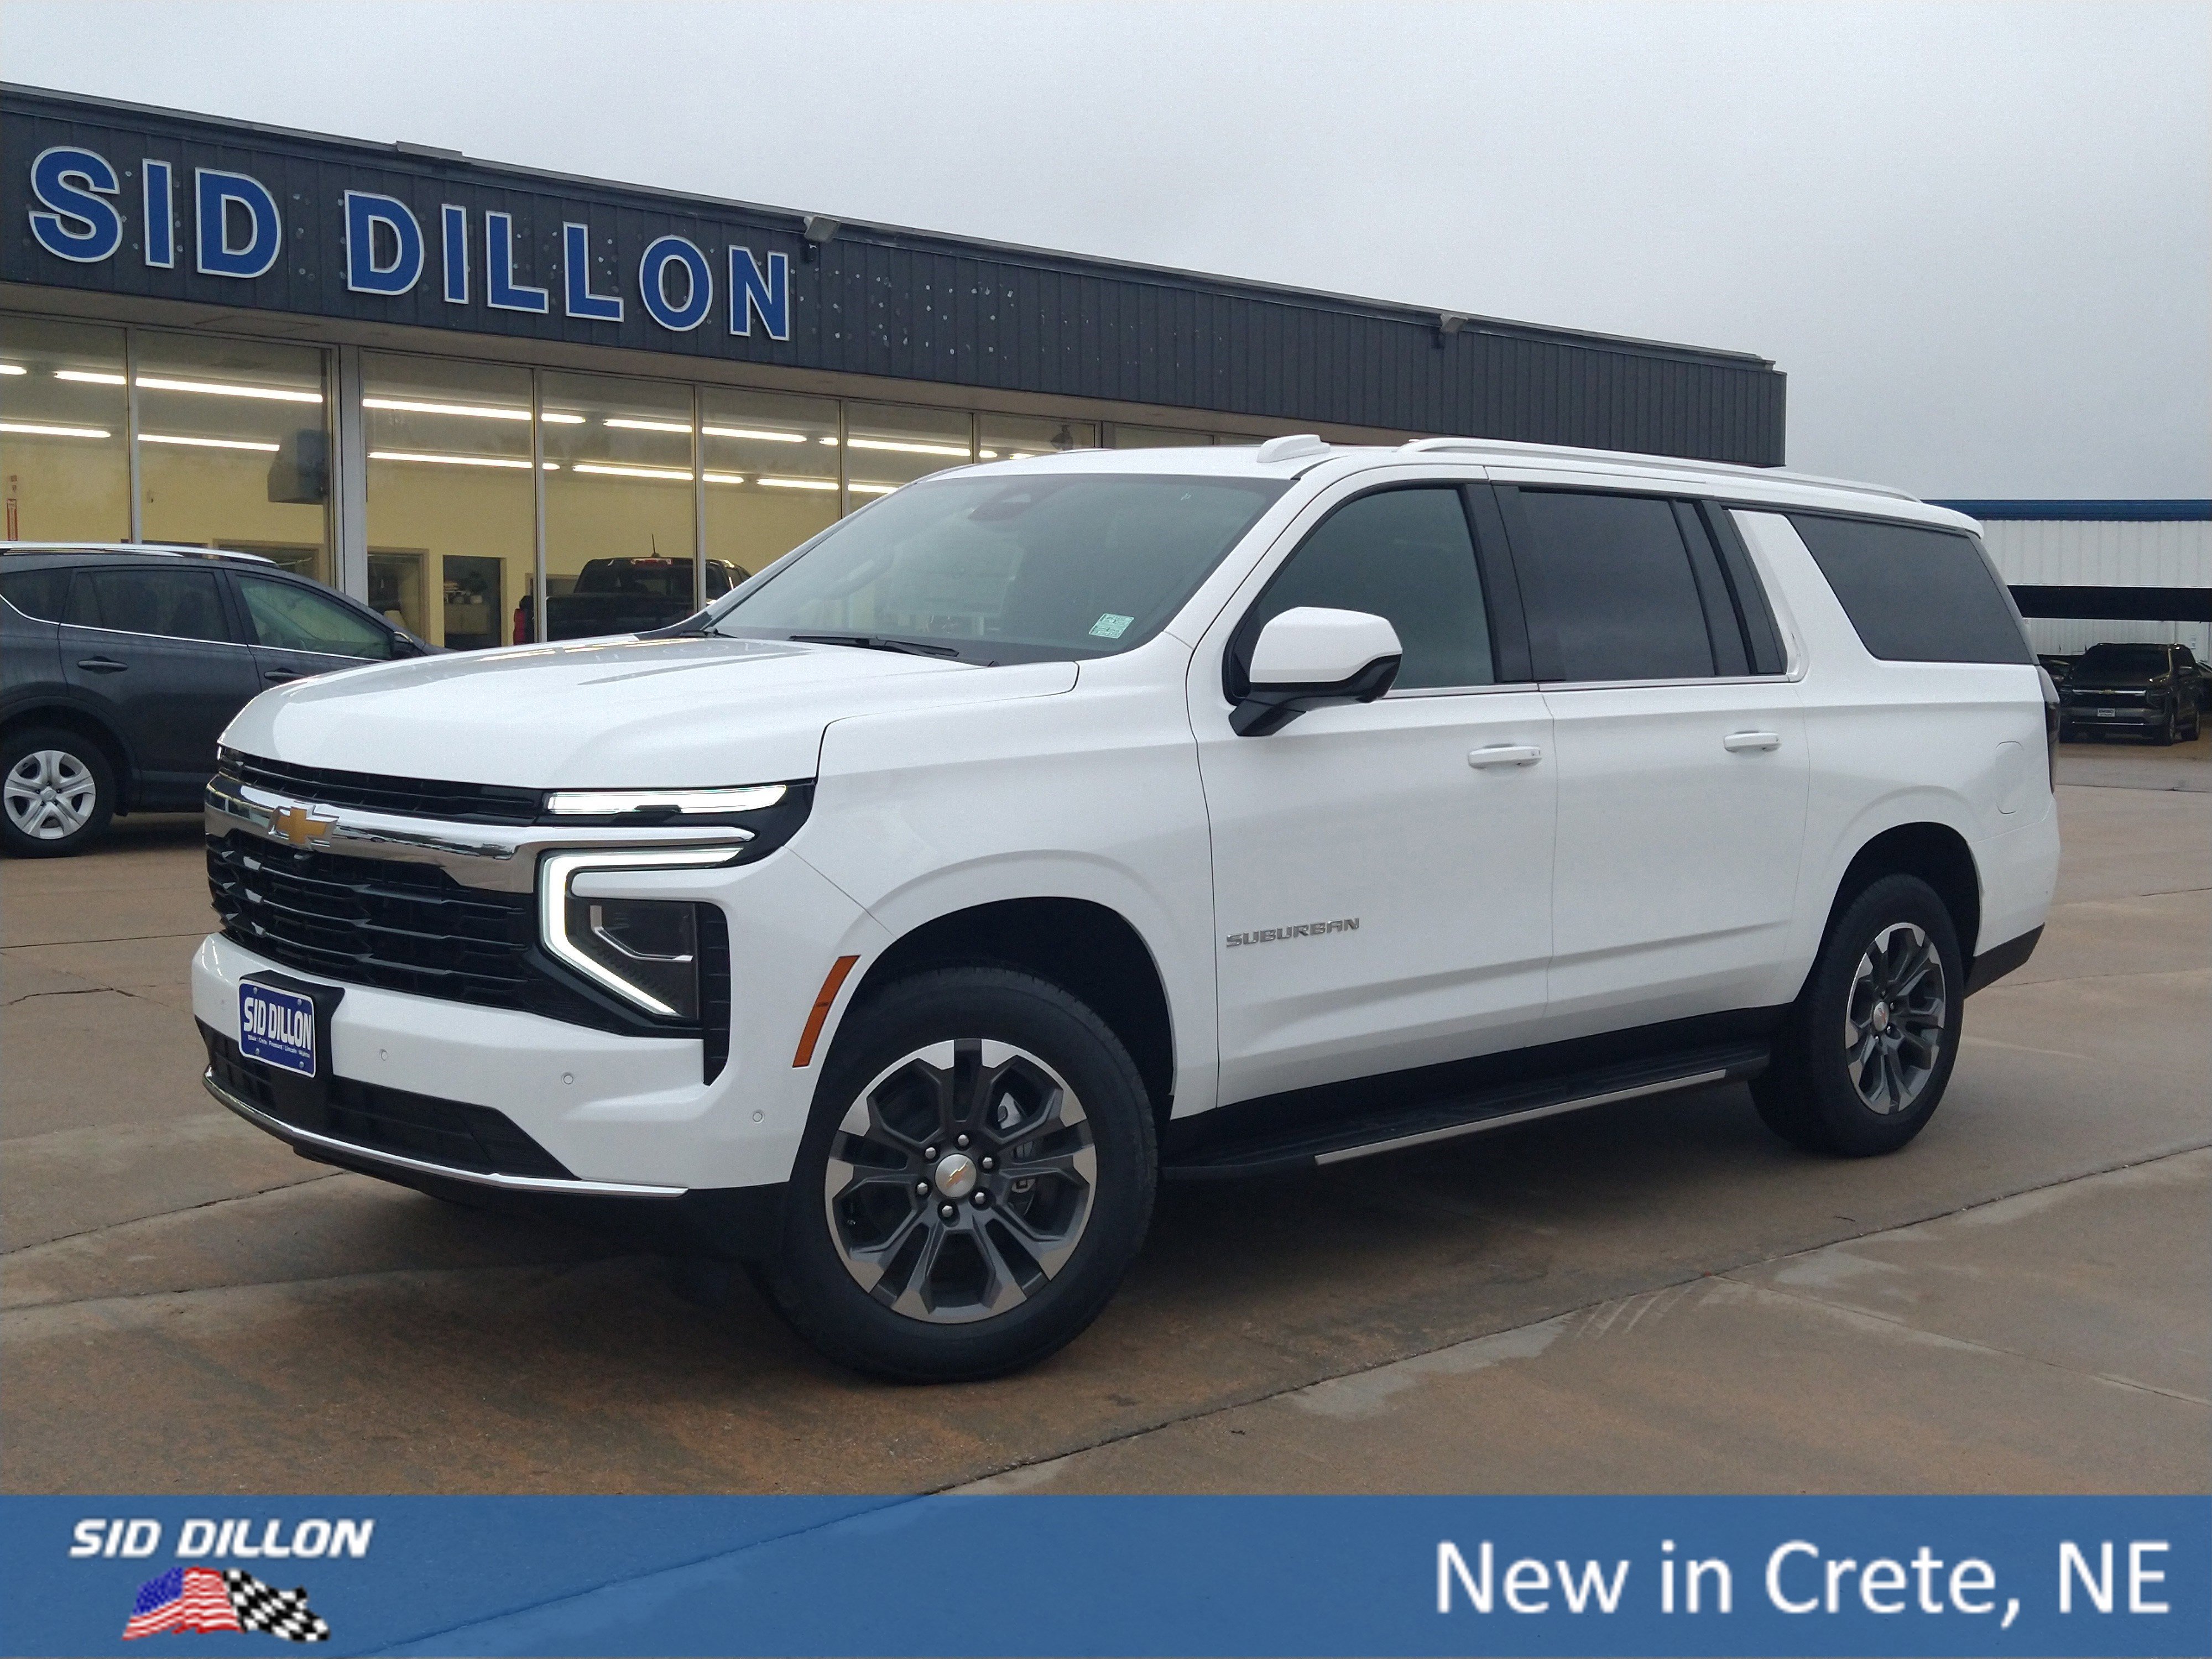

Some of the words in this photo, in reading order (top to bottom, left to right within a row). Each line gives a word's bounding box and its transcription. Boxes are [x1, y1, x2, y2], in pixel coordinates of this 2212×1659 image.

[29, 145, 281, 279] SID
[344, 189, 789, 341] DILLON
[1225, 918, 1359, 947] SUBURBAN
[244, 997, 267, 1036] SID
[268, 1003, 312, 1050] DILLON
